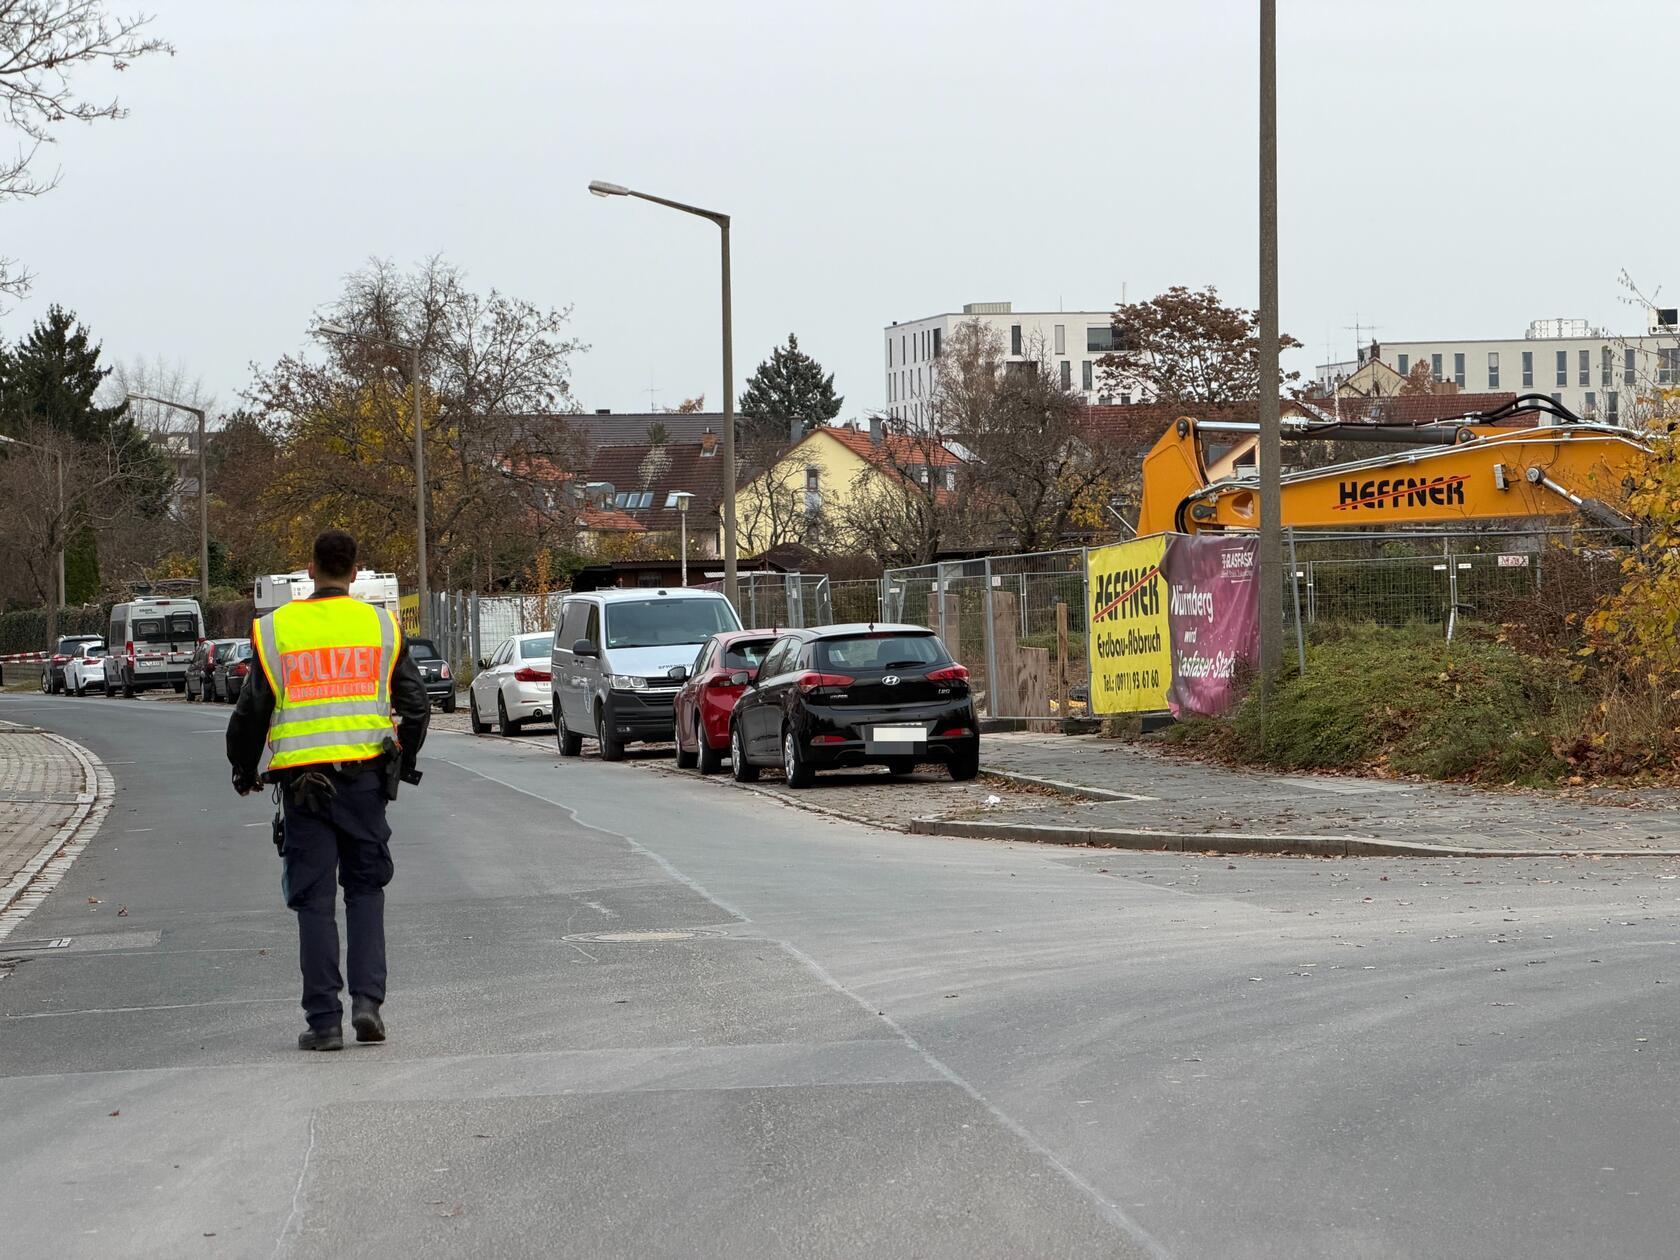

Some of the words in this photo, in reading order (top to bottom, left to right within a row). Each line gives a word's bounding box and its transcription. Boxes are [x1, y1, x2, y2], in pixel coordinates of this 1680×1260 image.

[1339, 475, 1465, 510] HEFFNER
[1095, 565, 1159, 623] HEFFNER
[1171, 585, 1214, 623] Nürnberg
[1097, 626, 1161, 658] Erdbau-Abbruch
[1184, 627, 1197, 643] wird
[282, 648, 374, 685] POLIZEI
[1104, 675, 1114, 692] Tel.:
[1115, 672, 1131, 696] (0911)
[1132, 671, 1140, 690] 93
[1142, 670, 1149, 688] 67
[1151, 669, 1159, 688] 60
